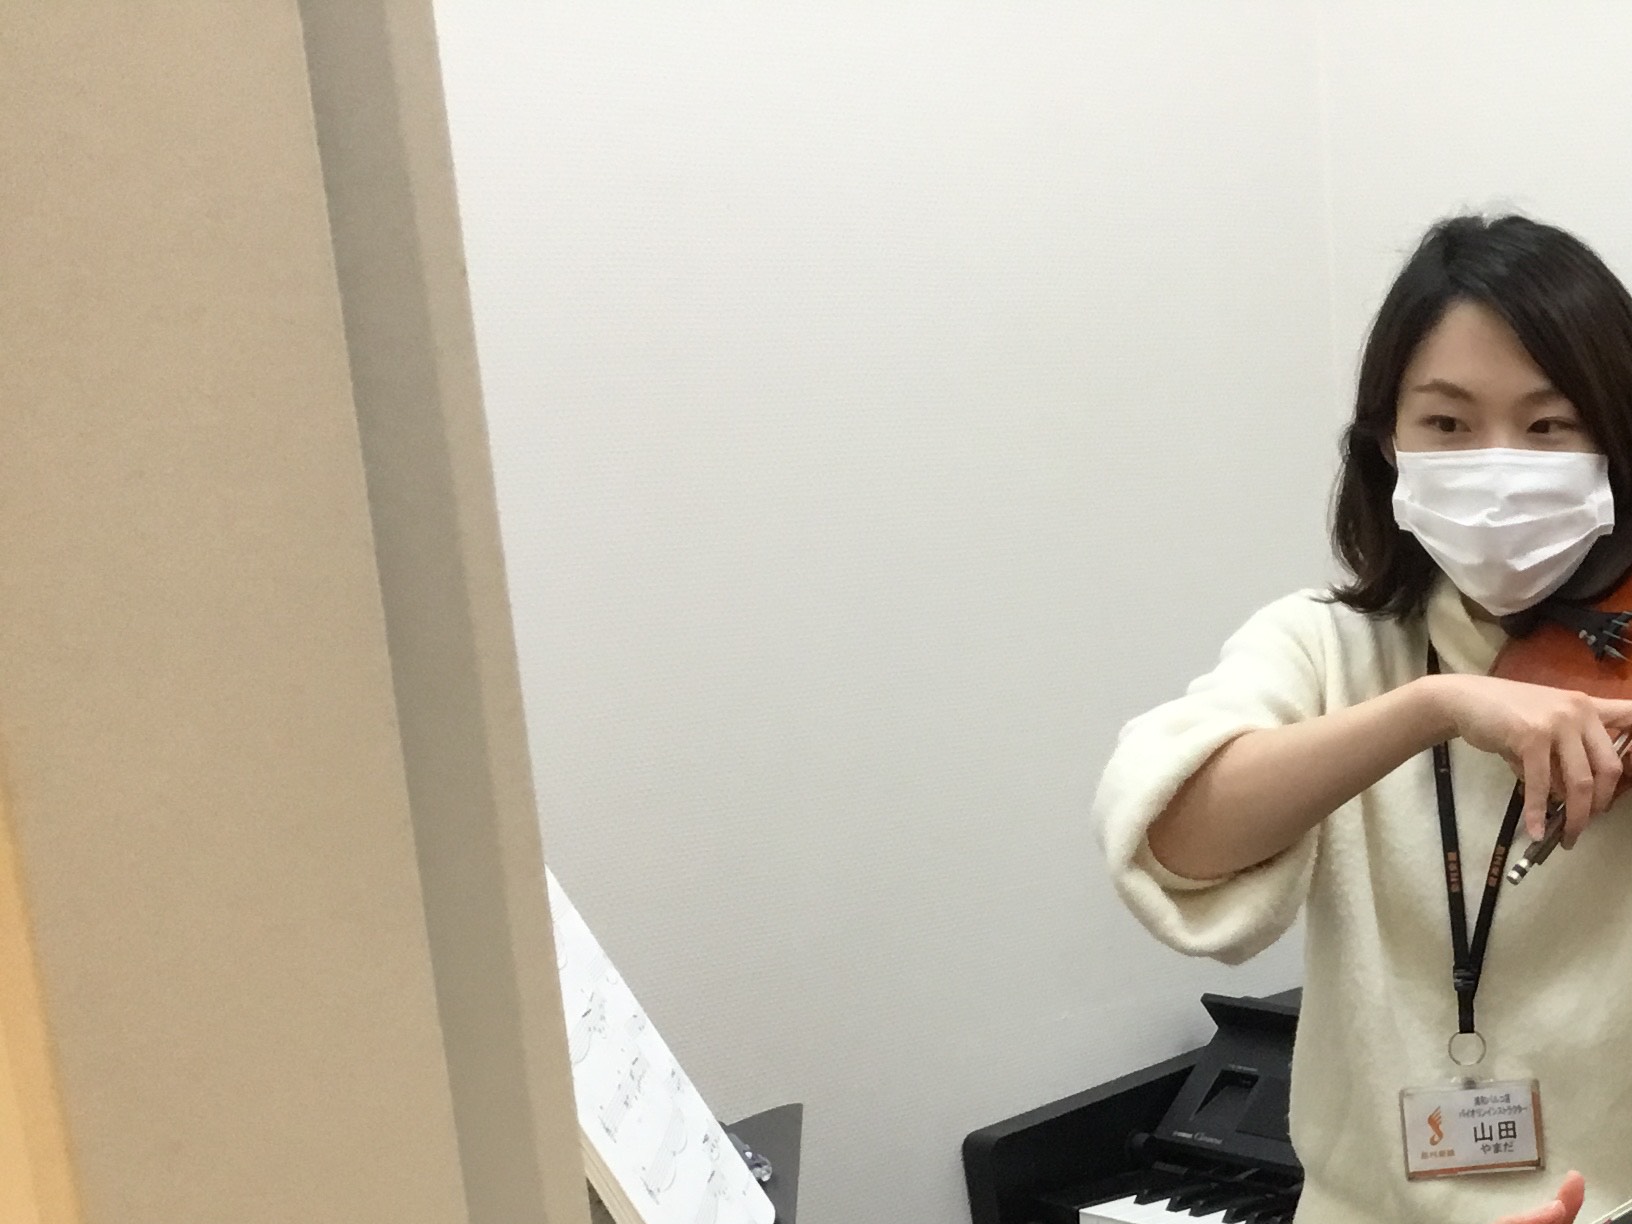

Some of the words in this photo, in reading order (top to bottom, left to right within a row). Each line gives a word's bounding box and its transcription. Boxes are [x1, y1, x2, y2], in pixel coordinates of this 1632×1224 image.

[1473, 1121, 1517, 1142] 山田
[1480, 1141, 1514, 1154] やまだ
